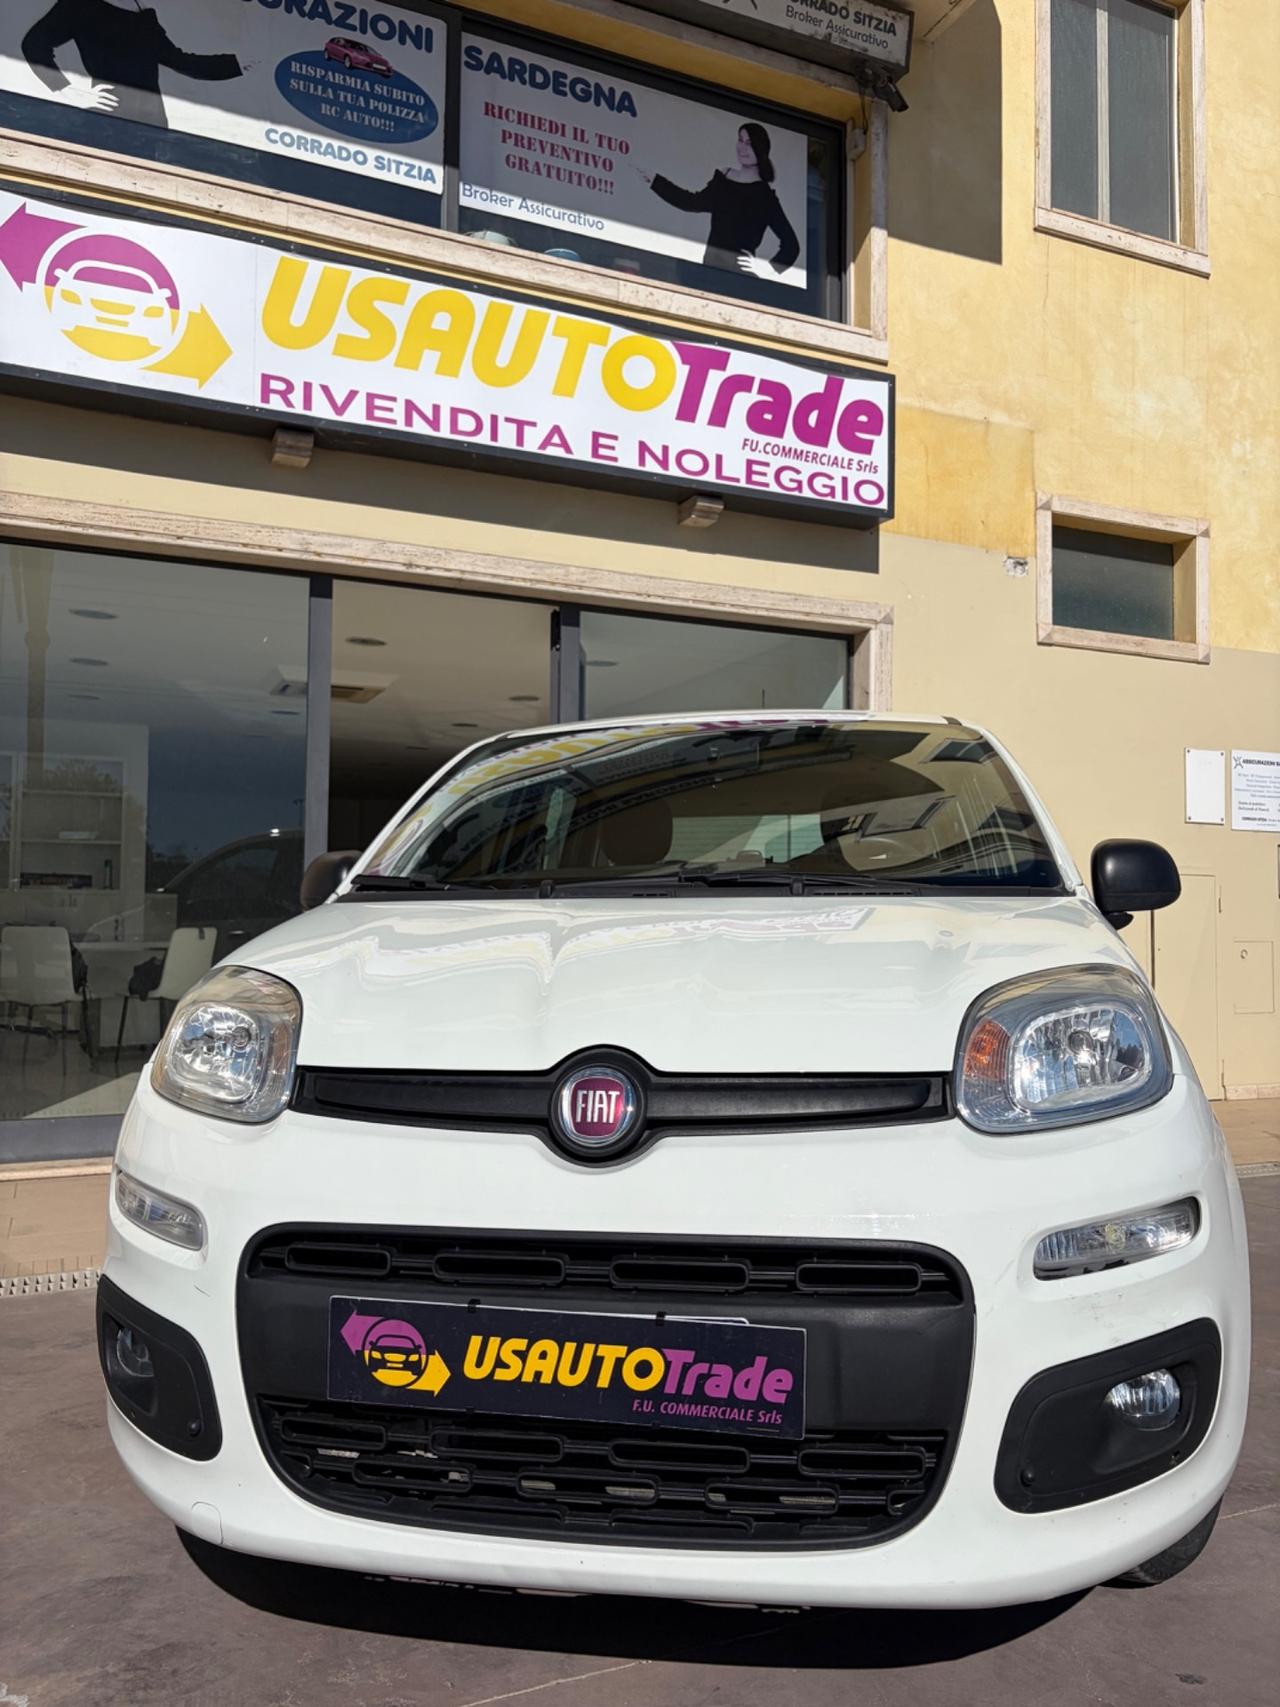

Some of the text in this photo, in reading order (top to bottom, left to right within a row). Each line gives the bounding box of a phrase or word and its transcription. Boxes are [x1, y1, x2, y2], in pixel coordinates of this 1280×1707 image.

[785, 5, 889, 49] Broker Assicurativo
[853, 11, 897, 36] SITZIA
[289, 79, 425, 123] SULLA TUA POLIZZA
[290, 61, 425, 107] RISPARMIA SUBITO
[463, 45, 637, 118] SARDEGNA
[320, 103, 395, 132] RC AUTO!!!
[483, 101, 630, 155] RICHIEDI IL TUO
[264, 128, 437, 184] CORRADO SITZIA
[501, 128, 614, 172] PREVENTIVO
[505, 153, 614, 195] GRATUITO!!!
[461, 182, 605, 231] Broker Assicurativo
[260, 373, 885, 505] RIVENDITA E NOLEGGIO
[856, 460, 879, 475] Srls
[575, 1089, 620, 1124] FIAT
[632, 1399, 783, 1424] F.U. COMMERCIALE Srls
